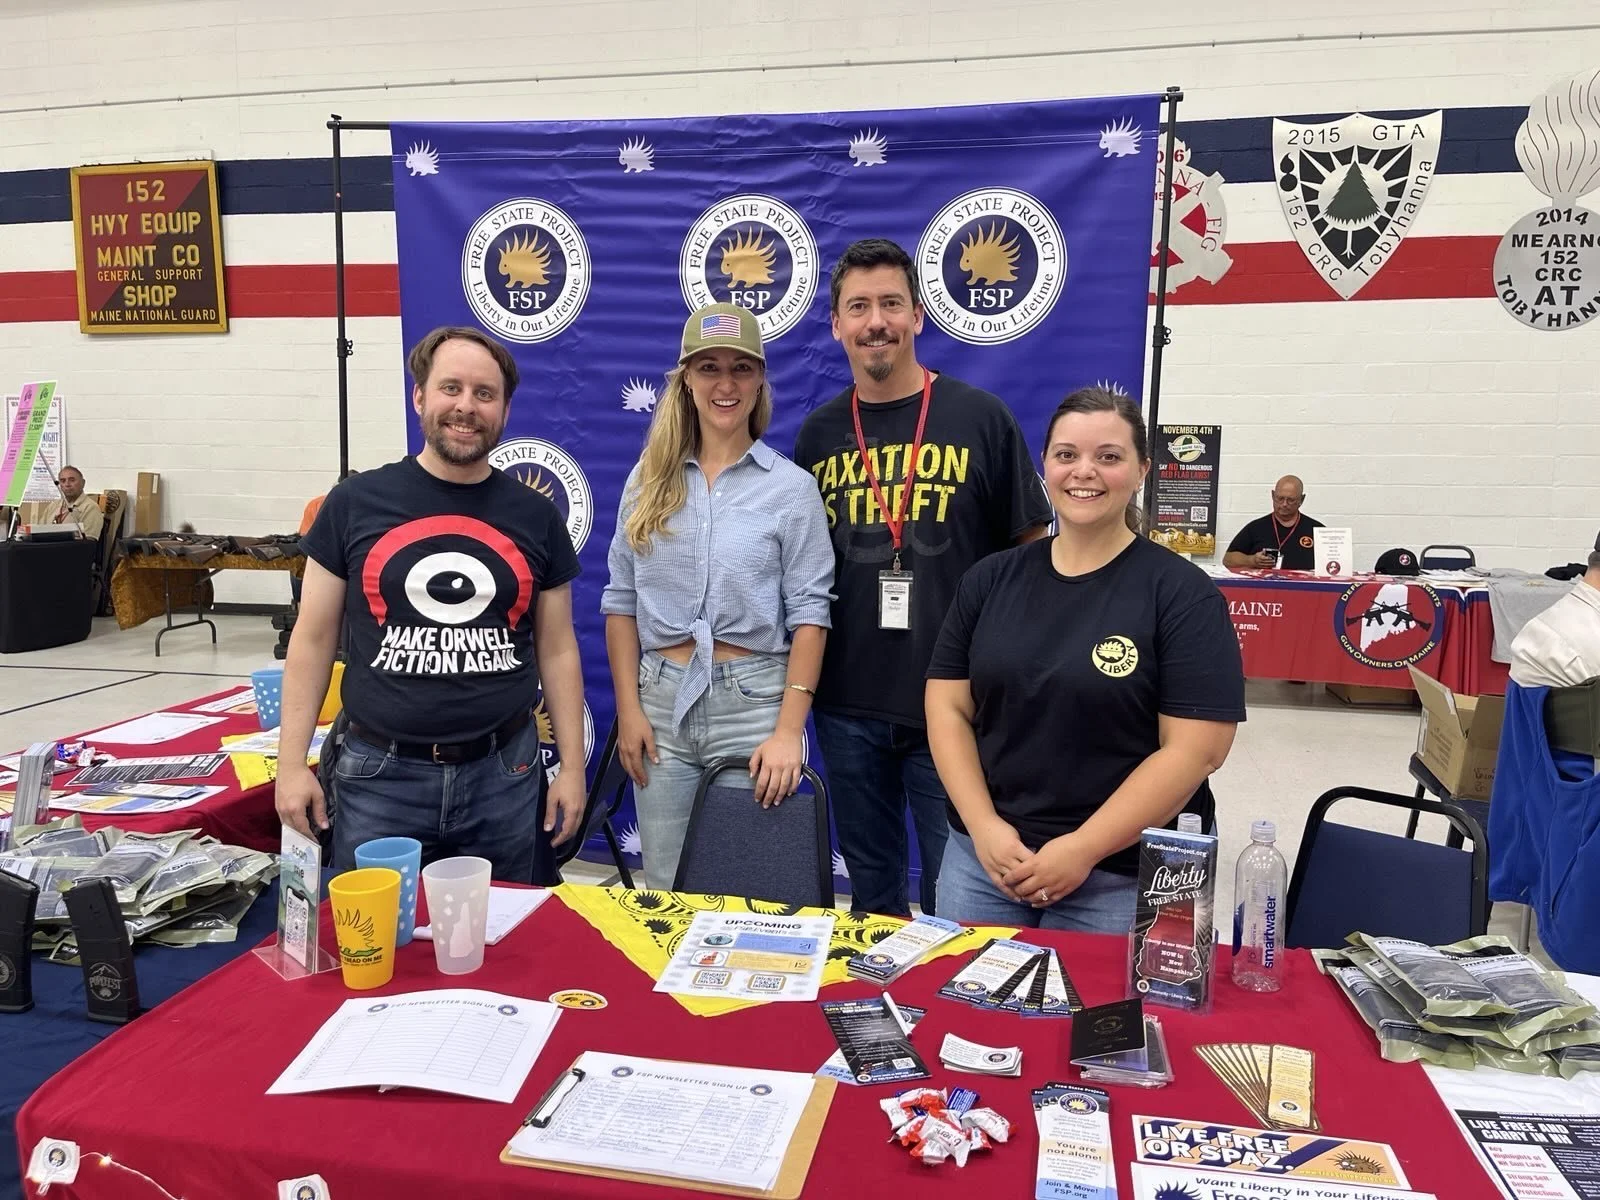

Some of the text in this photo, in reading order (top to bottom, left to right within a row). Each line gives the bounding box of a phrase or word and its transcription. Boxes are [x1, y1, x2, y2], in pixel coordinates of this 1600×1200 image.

[1287, 123, 1425, 146] 2015 GTA
[126, 179, 166, 203] 152
[90, 211, 201, 236] HVY EQUIP
[1286, 196, 1307, 230] 152
[1354, 160, 1432, 277] Tobyhanna
[1536, 208, 1589, 227] 2014
[471, 207, 581, 269] FREE STATE PROJECT
[690, 203, 809, 268] FREE STATE PROJECT
[926, 197, 1055, 265] FREE STATE PROJECT
[1511, 233, 1600, 248] MEARN
[96, 245, 200, 268] MAINT CO
[1308, 243, 1342, 282] CRC
[1540, 250, 1578, 265] 152
[97, 268, 203, 282] GENERAL SUPPORT
[1535, 268, 1582, 282] CRC
[123, 285, 177, 307] SHOP
[473, 278, 581, 332] Liberty in Our Lifetime
[508, 290, 547, 309] FSP
[691, 281, 709, 309] Libe
[729, 290, 771, 310] FSP
[769, 277, 808, 327] Lifetime
[927, 273, 1054, 333] Liberty in Our Lifetime
[968, 288, 1013, 308] FSP
[1534, 286, 1580, 306] AT
[90, 309, 216, 322] MAINE NATIONAL GUARD
[1162, 425, 1213, 435] NOVEMBER 4TH
[495, 447, 583, 508] STATE PROJECT
[812, 443, 969, 493] TAXATION
[1160, 470, 1173, 478] RED
[1174, 471, 1189, 479] FLAG
[824, 483, 956, 529] S THEFT
[1422, 583, 1442, 608] IGHTS
[381, 625, 515, 651] MAKE ORWELL
[1239, 623, 1260, 632] arms,
[370, 647, 522, 674] FICTION AGAIN
[1100, 645, 1136, 674] LIBERTY
[1340, 635, 1354, 653] GUN
[1353, 652, 1393, 668] OWNERS
[1408, 641, 1435, 664] MAINE
[1146, 842, 1207, 858] FreeStateProject.org
[1143, 865, 1207, 897] Liberty
[1147, 890, 1203, 907] FREE STATE
[725, 919, 802, 929] UPCOMING
[1265, 896, 1276, 969] smartwater
[654, 1074, 710, 1086] NEWSLETTER
[1467, 1119, 1570, 1134] LIVE FREE AND
[1480, 1129, 1529, 1142] CARRY
[1529, 1132, 1550, 1143] IN
[1548, 1133, 1573, 1145] NH
[1056, 1141, 1097, 1153] You are
[1143, 1122, 1292, 1155] LIVE FREE
[1068, 1151, 1102, 1162] alone!
[1143, 1138, 1296, 1171] OR SPAZ.
[1045, 1180, 1062, 1188] Join
[1073, 1184, 1098, 1194] Move!
[1054, 1188, 1088, 1199] FSP.org
[1195, 1177, 1237, 1188] Want
[1240, 1182, 1292, 1197] Liberty
[1296, 1187, 1310, 1196] in
[1315, 1190, 1349, 1199] Your
